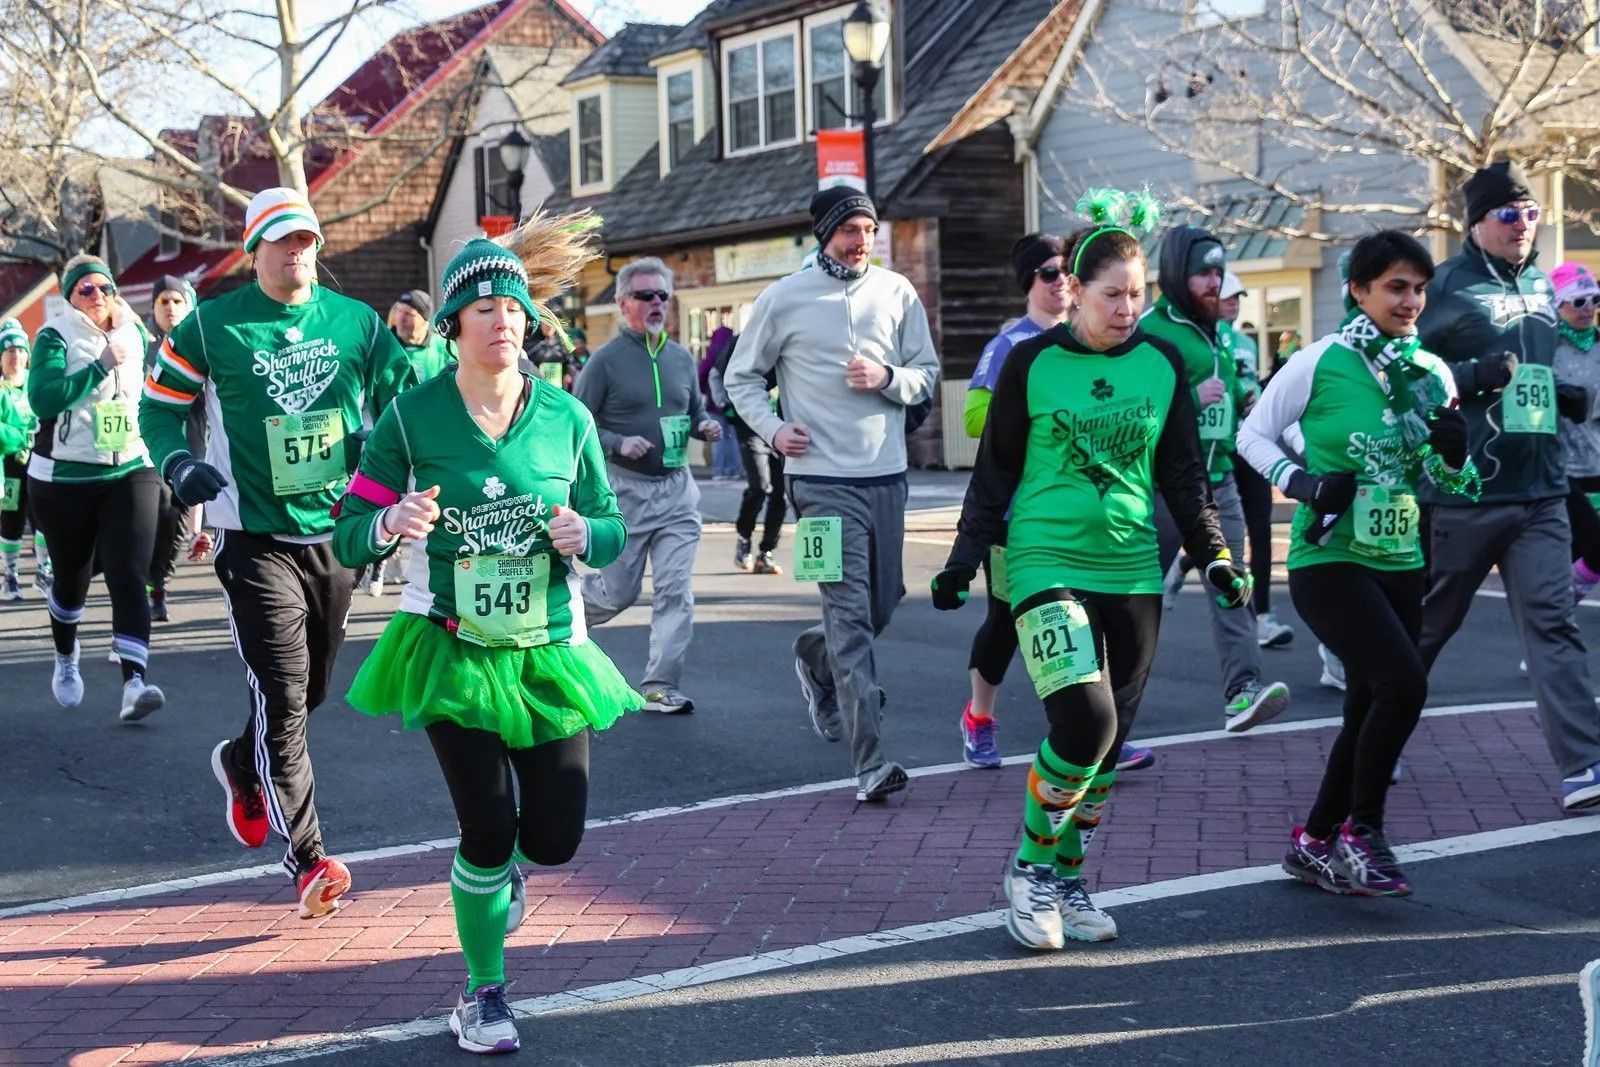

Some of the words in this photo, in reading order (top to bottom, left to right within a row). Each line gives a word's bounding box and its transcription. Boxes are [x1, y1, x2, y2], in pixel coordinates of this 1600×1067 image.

[252, 338, 340, 377] Shamrock
[266, 357, 340, 398] Shuffle
[1516, 383, 1550, 409] 593
[1051, 396, 1158, 441] Shamrock
[284, 433, 331, 465] 575
[1070, 421, 1157, 467] Shuffle
[442, 494, 549, 535] Shamrock
[471, 492, 533, 515] NEWTOWN
[458, 518, 545, 555] Shuffle
[1369, 507, 1409, 537] 335
[497, 558, 534, 568] SHAMROCK
[803, 536, 823, 559] 18
[498, 567, 523, 577] SHUFFLE
[525, 566, 534, 576] 5K
[474, 581, 532, 617] 543
[1031, 624, 1079, 663] 421
